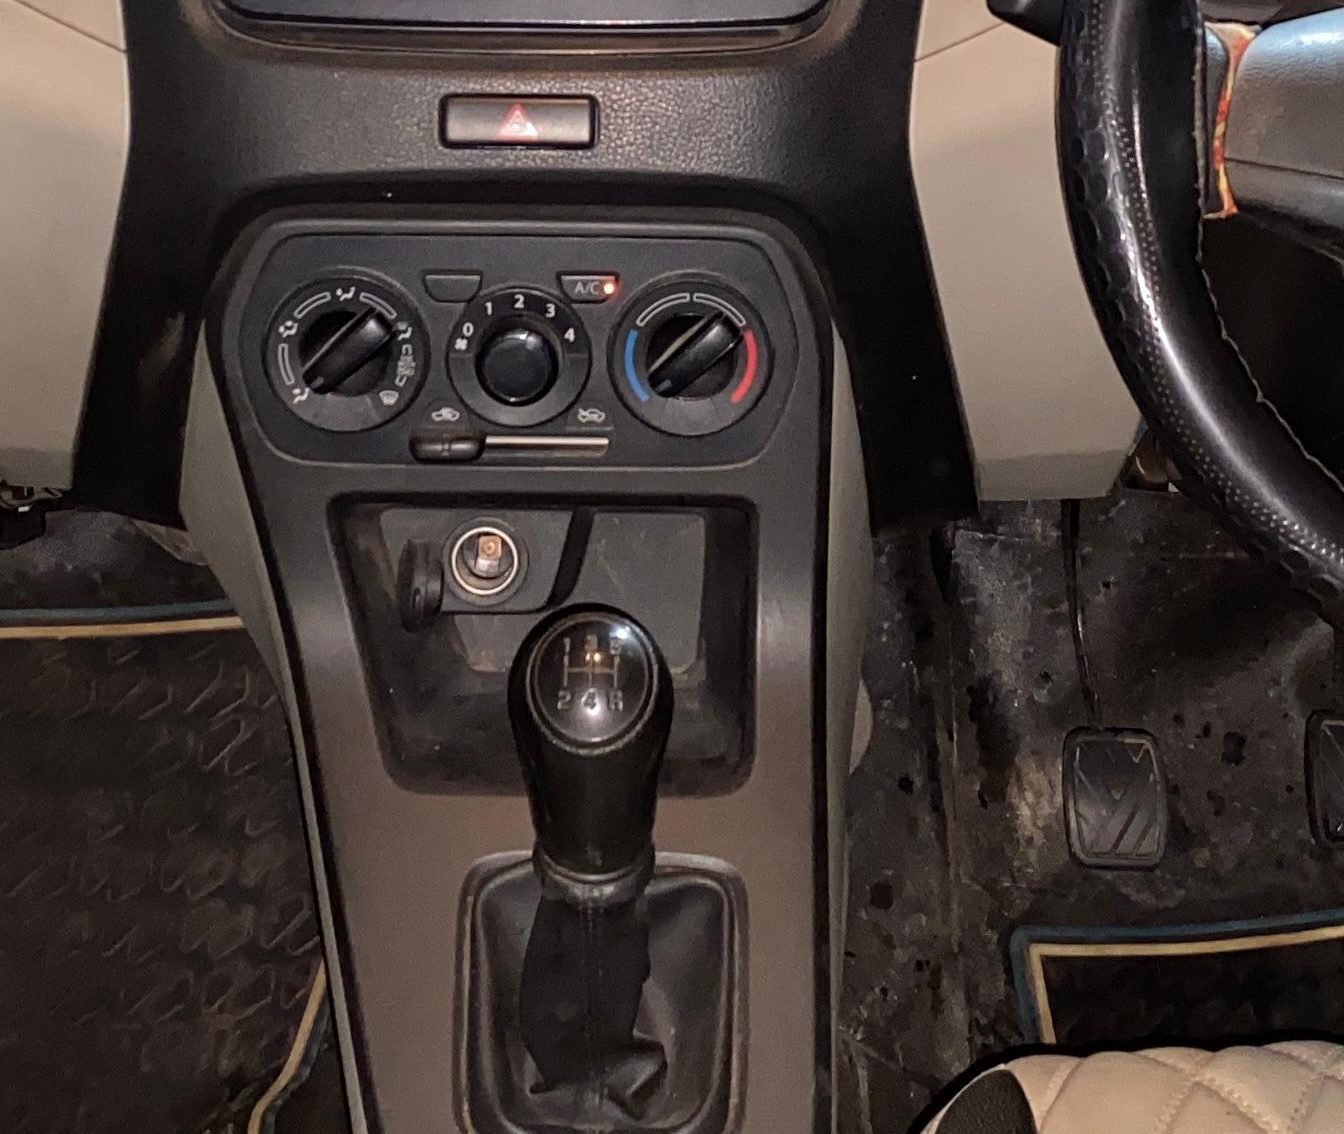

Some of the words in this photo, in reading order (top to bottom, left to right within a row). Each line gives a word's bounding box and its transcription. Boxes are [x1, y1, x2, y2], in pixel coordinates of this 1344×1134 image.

[574, 282, 600, 295] A/C
[462, 322, 474, 336] 0
[485, 302, 493, 316] 1
[514, 294, 525, 309] 2
[546, 303, 556, 318] 3
[564, 327, 576, 343] 4
[557, 690, 572, 709] 2
[581, 688, 597, 709] 4
